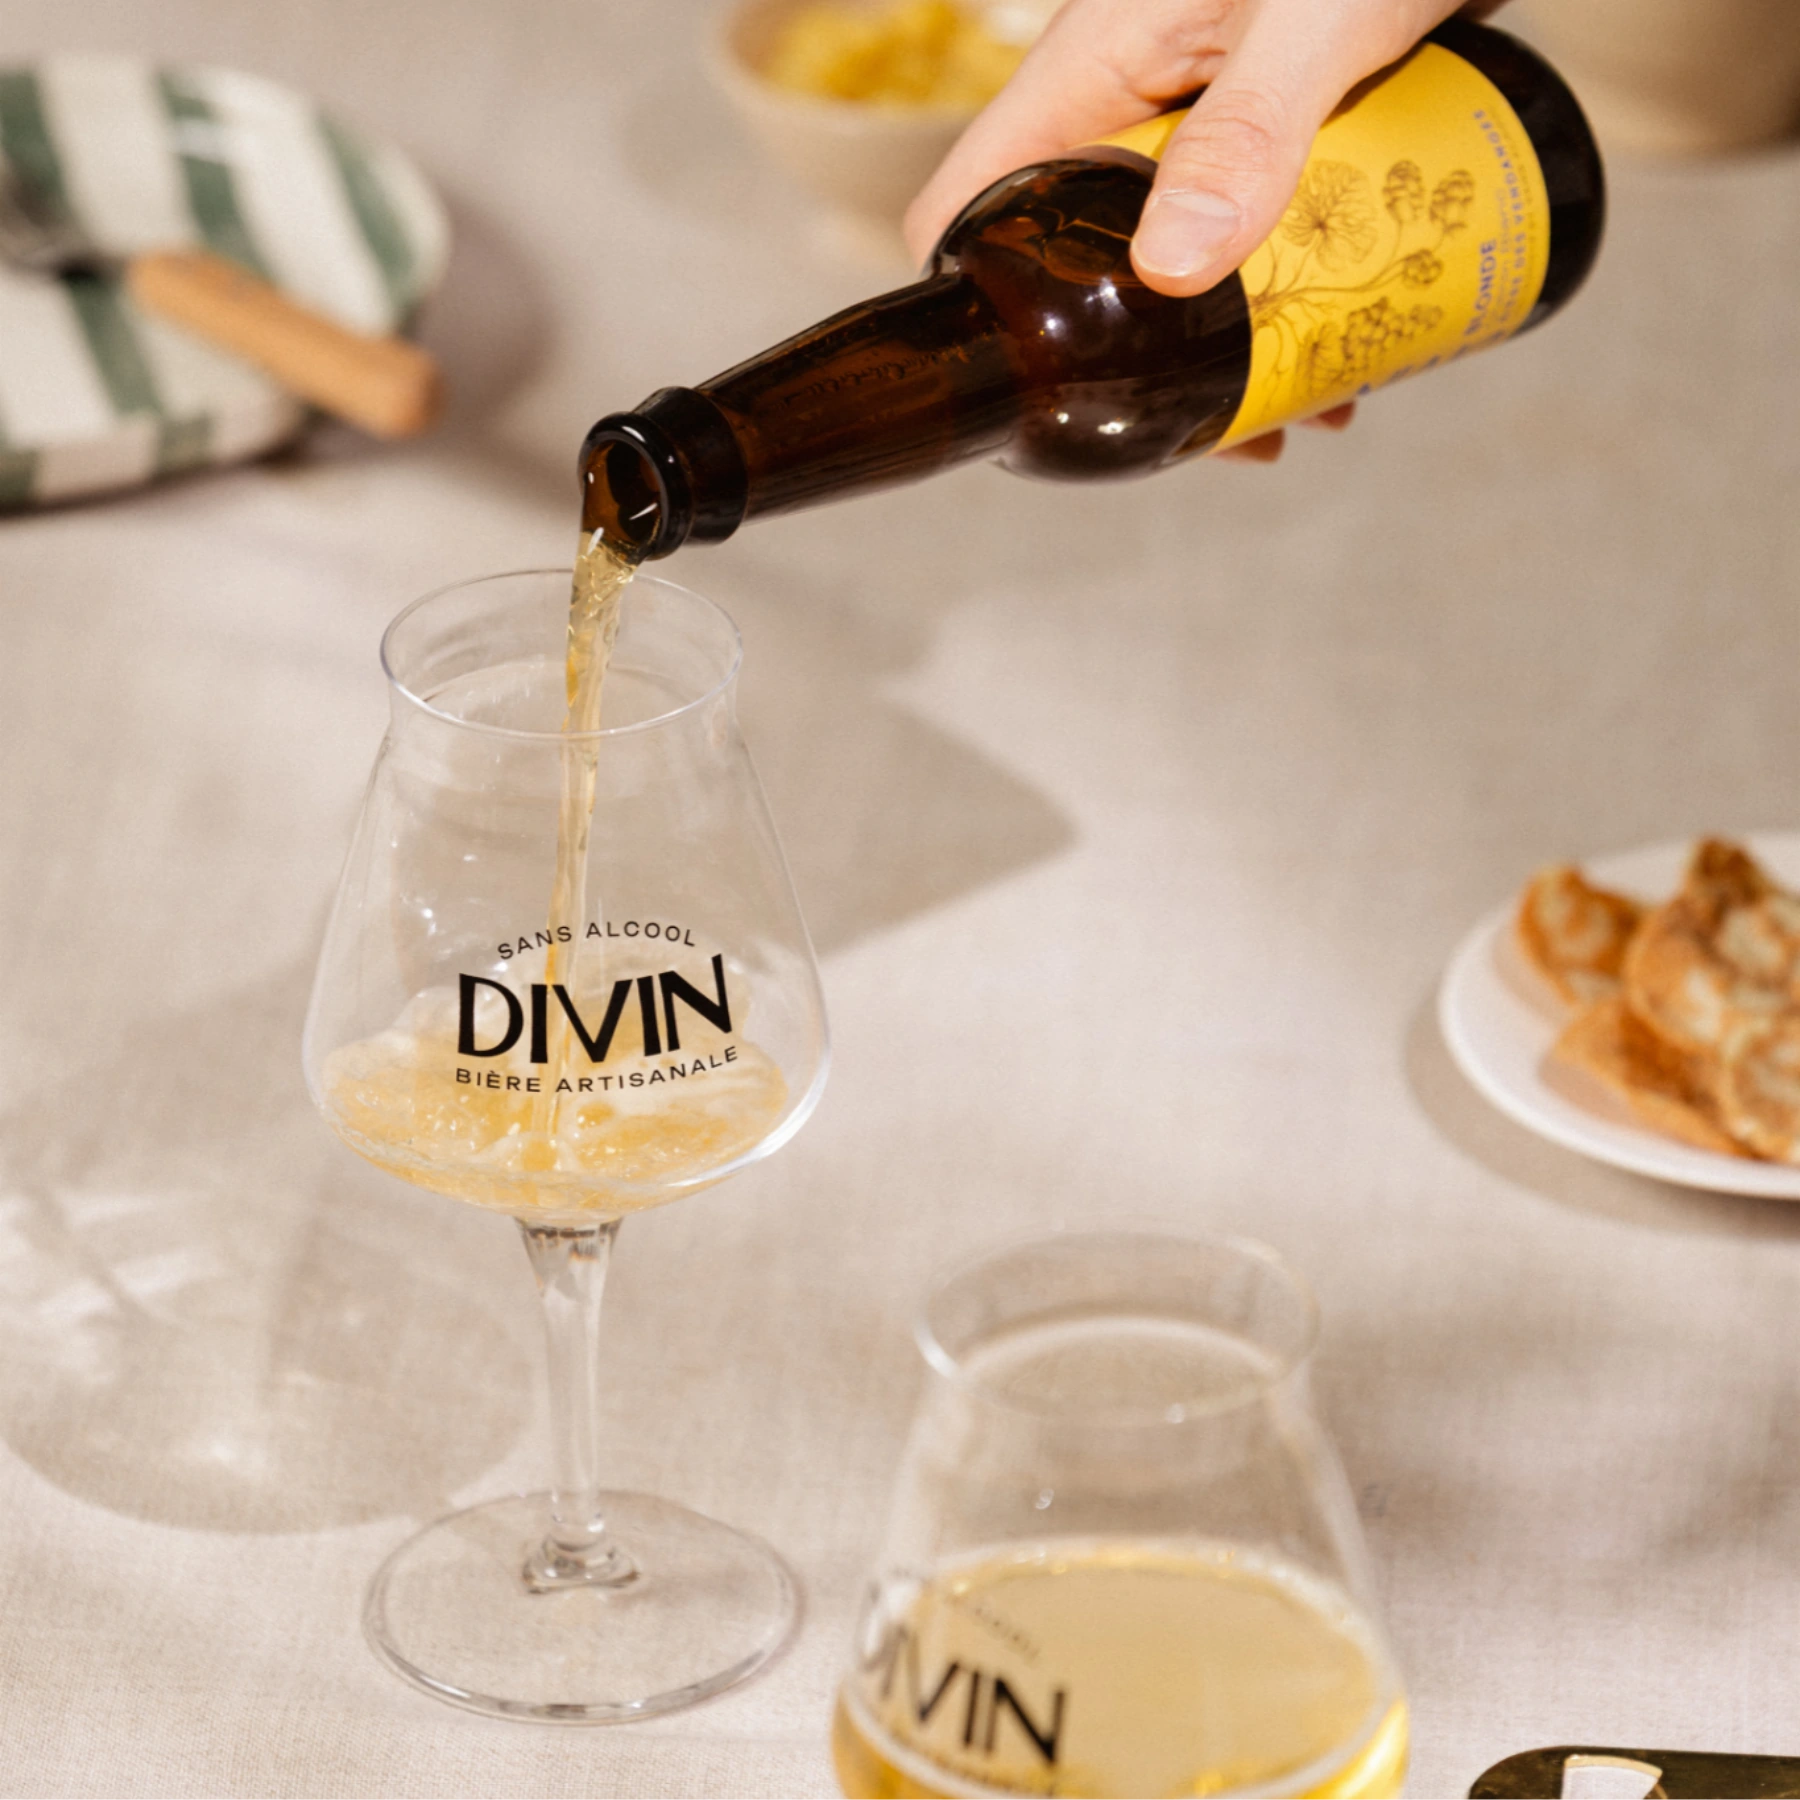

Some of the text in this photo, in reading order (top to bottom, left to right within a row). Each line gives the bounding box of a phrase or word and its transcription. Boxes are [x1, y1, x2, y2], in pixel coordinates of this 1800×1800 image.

[497, 920, 696, 960] SANS ALCOOL
[457, 953, 733, 1064] DIVIN
[455, 1045, 739, 1093] BIÈRE ARTISANALE
